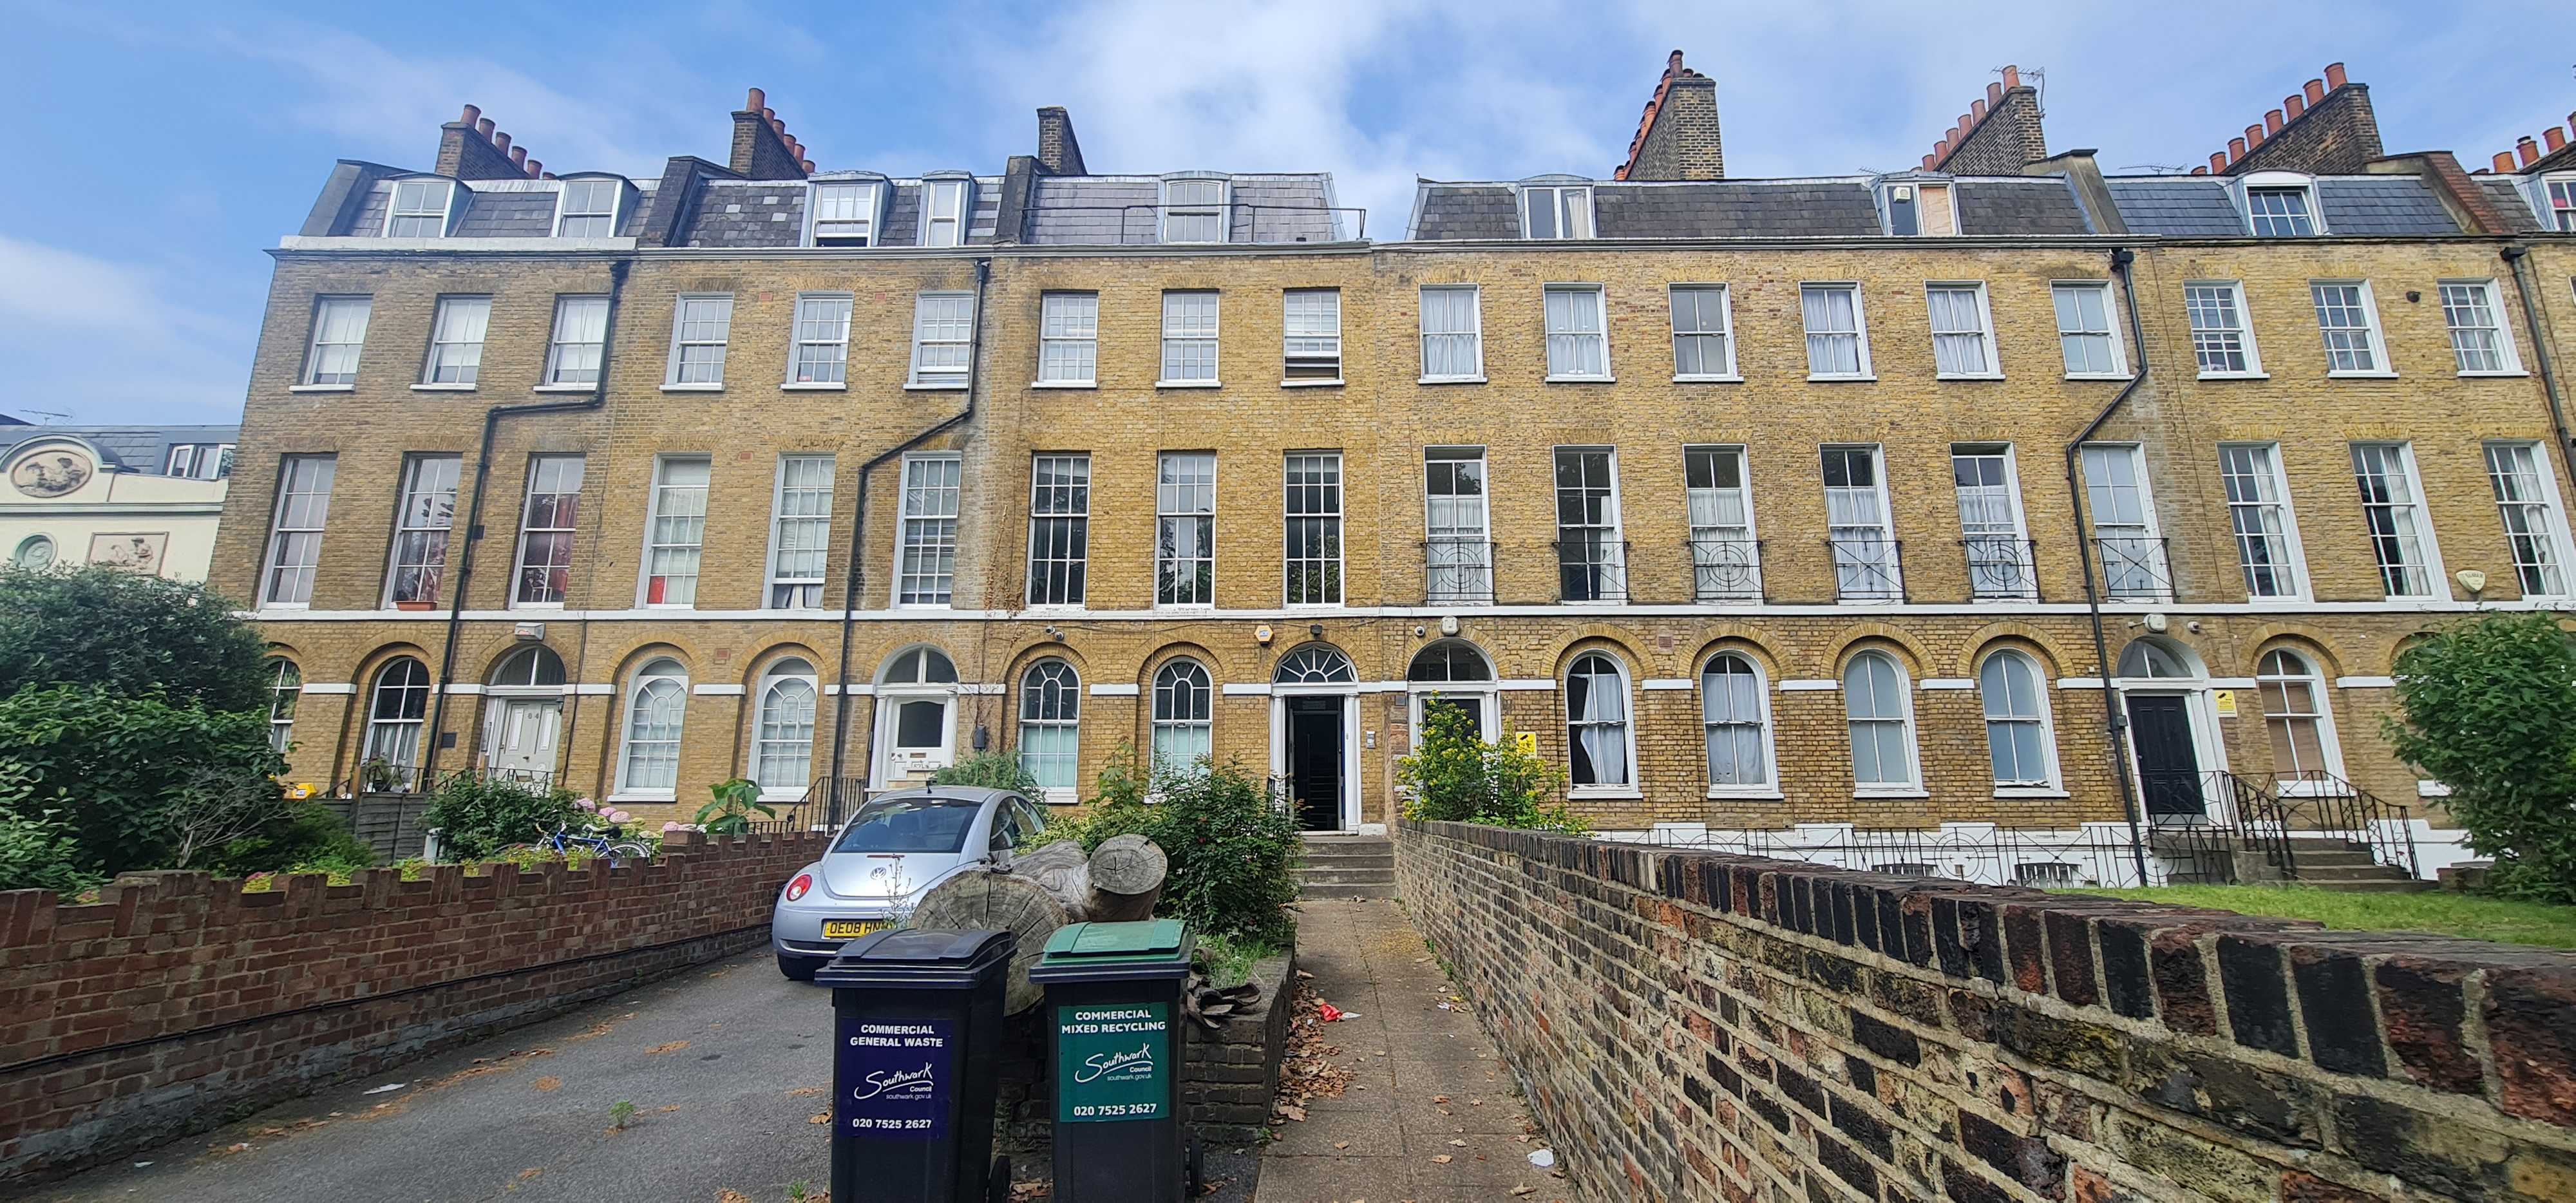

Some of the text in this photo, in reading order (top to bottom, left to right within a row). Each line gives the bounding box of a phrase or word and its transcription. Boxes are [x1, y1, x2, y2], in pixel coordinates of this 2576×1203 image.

[829, 922, 862, 934] OE08
[1075, 1009, 1151, 1021] COMMERCIAL
[861, 1025, 934, 1034] COMMERCIAL
[1061, 1021, 1166, 1034] MIXED RECYCLING
[850, 1037, 943, 1047] GENERAL WASTE
[1075, 1043, 1152, 1083] Southwark
[854, 1062, 933, 1099] Southwark
[1107, 1073, 1152, 1081] southwark.gov.uk
[1074, 1103, 1157, 1116] 020 7525 2627
[853, 1119, 932, 1129] 020 7525 2627
